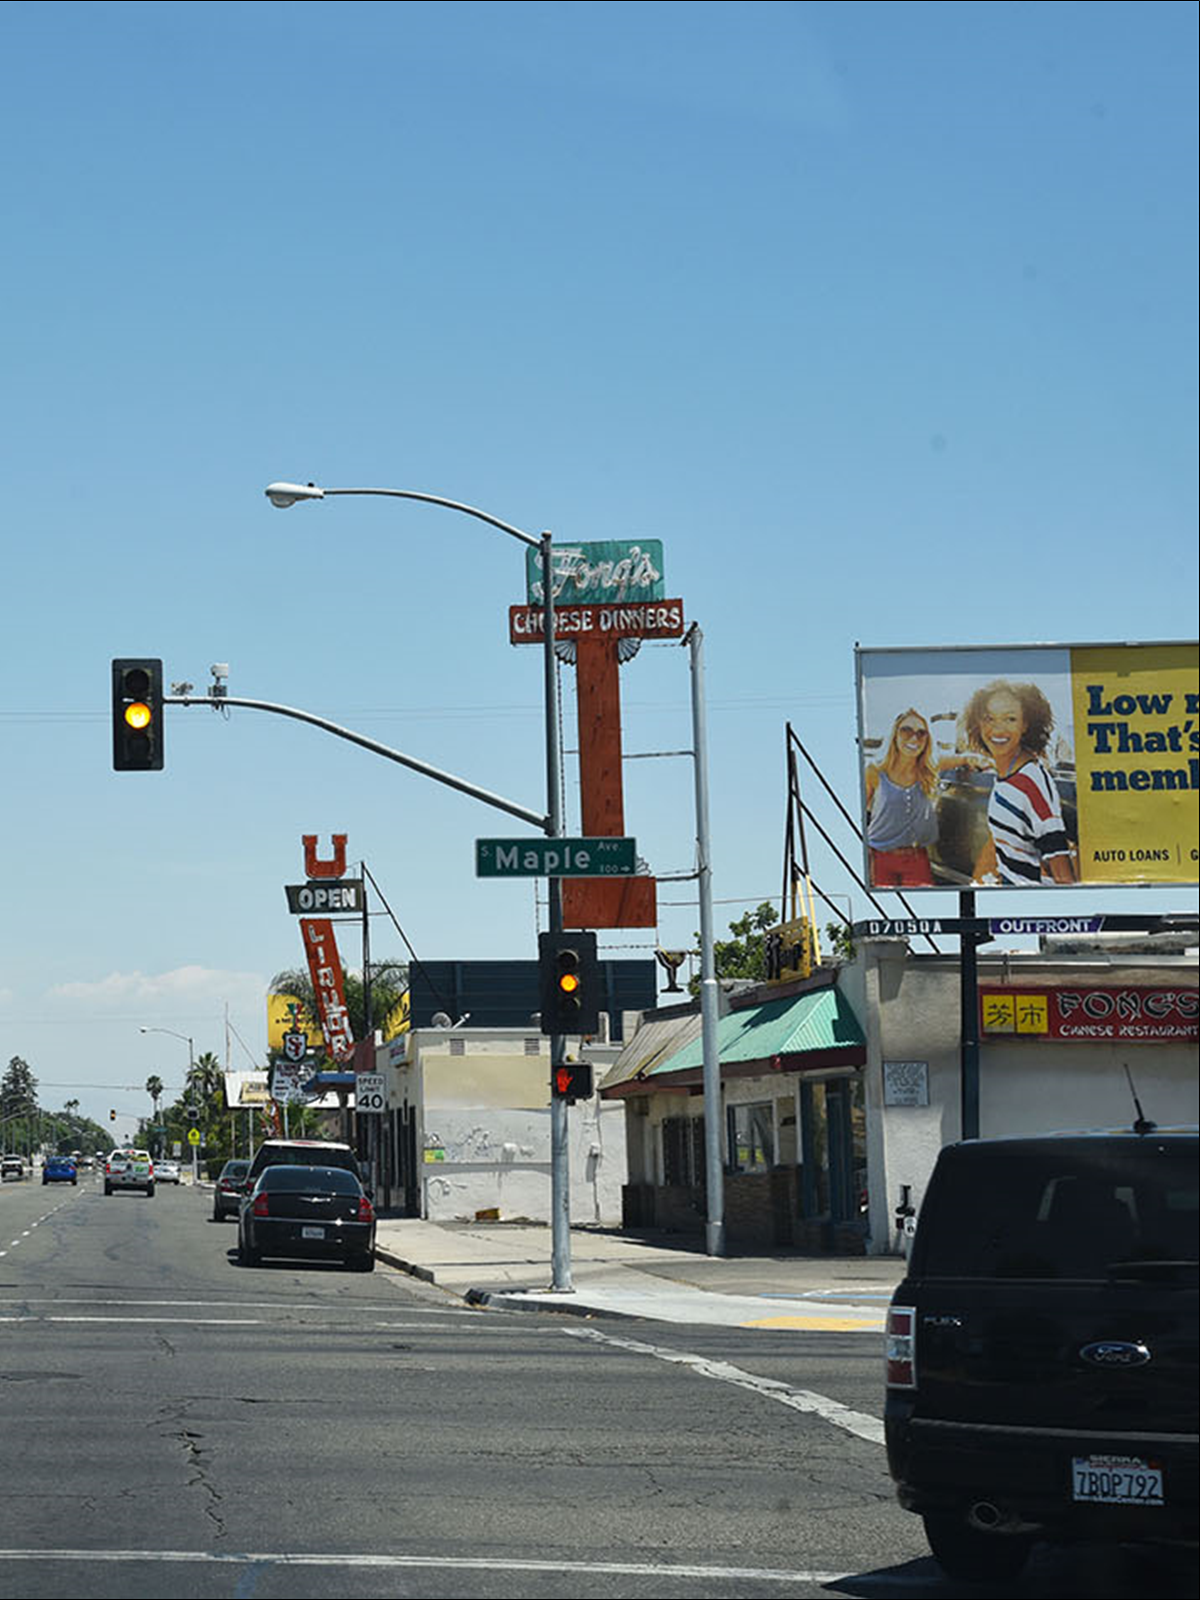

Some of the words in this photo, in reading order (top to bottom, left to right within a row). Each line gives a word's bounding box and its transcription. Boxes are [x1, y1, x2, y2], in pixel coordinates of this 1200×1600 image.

[532, 546, 660, 601] Fong's
[599, 606, 681, 632] DINNERS
[1086, 685, 1173, 716] Low
[495, 846, 591, 874] Maple
[597, 841, 620, 851] Ave
[1093, 850, 1127, 862] AUTO
[1129, 849, 1170, 861] LOANS
[298, 887, 357, 909] OPEN
[999, 918, 1093, 934] OUTFRONT
[1119, 1025, 1198, 1036] RESTAURANT
[358, 1077, 384, 1085] SPEED
[358, 1094, 383, 1109] 40
